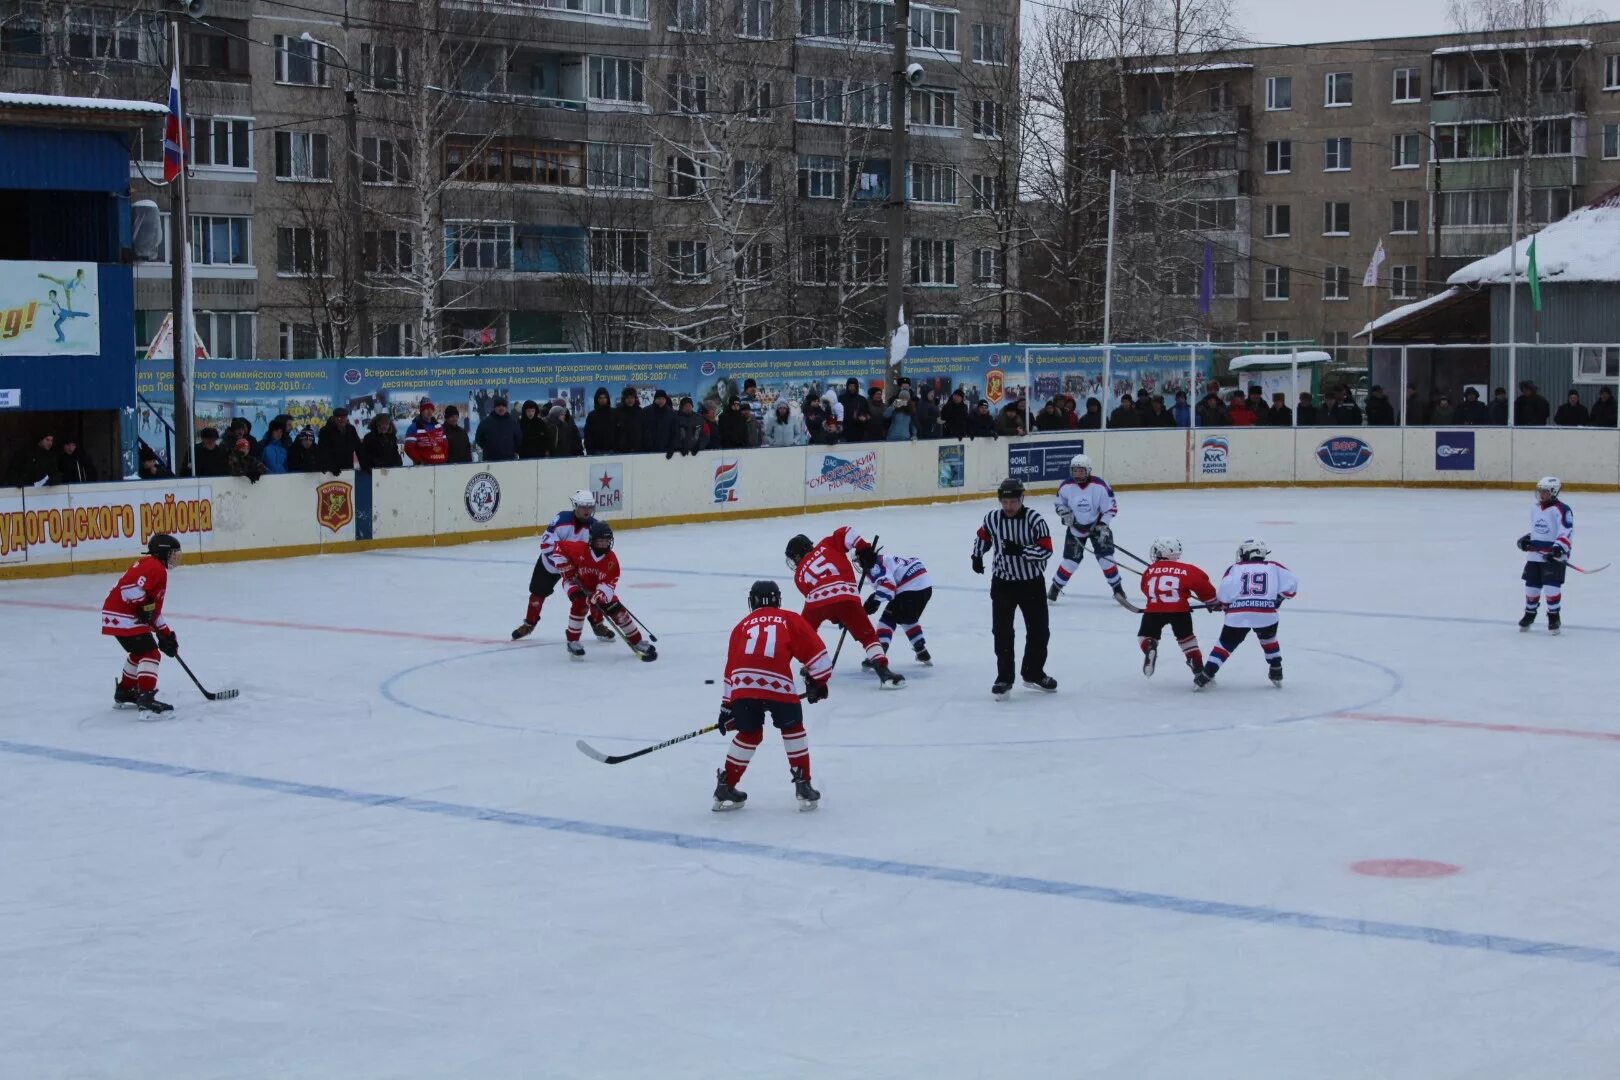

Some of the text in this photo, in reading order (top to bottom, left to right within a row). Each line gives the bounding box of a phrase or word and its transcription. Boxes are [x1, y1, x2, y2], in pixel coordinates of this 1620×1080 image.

[220, 370, 282, 381] олимпийского
[364, 367, 428, 378] Всероссийский
[430, 367, 456, 377] турнир
[458, 367, 480, 376] юных
[481, 365, 525, 375] хоккеистов
[526, 364, 553, 374] памяти
[555, 363, 603, 375] трехкратного
[604, 362, 653, 373] олимпийского
[255, 381, 300, 391] 2008-2010
[382, 379, 443, 390] десятикратного
[445, 378, 483, 388] чемпиона
[485, 377, 506, 387] мира
[508, 375, 553, 386] Александра
[631, 371, 667, 382] 2005-2007
[1010, 456, 1027, 465] ФОНД
[1010, 465, 1039, 474] ТИМЧЕНКО
[139, 493, 213, 545] района
[803, 555, 841, 586] 15
[137, 575, 147, 588] 6
[1147, 575, 1181, 603] 19
[1240, 572, 1269, 596] 19
[744, 624, 777, 658] 11
